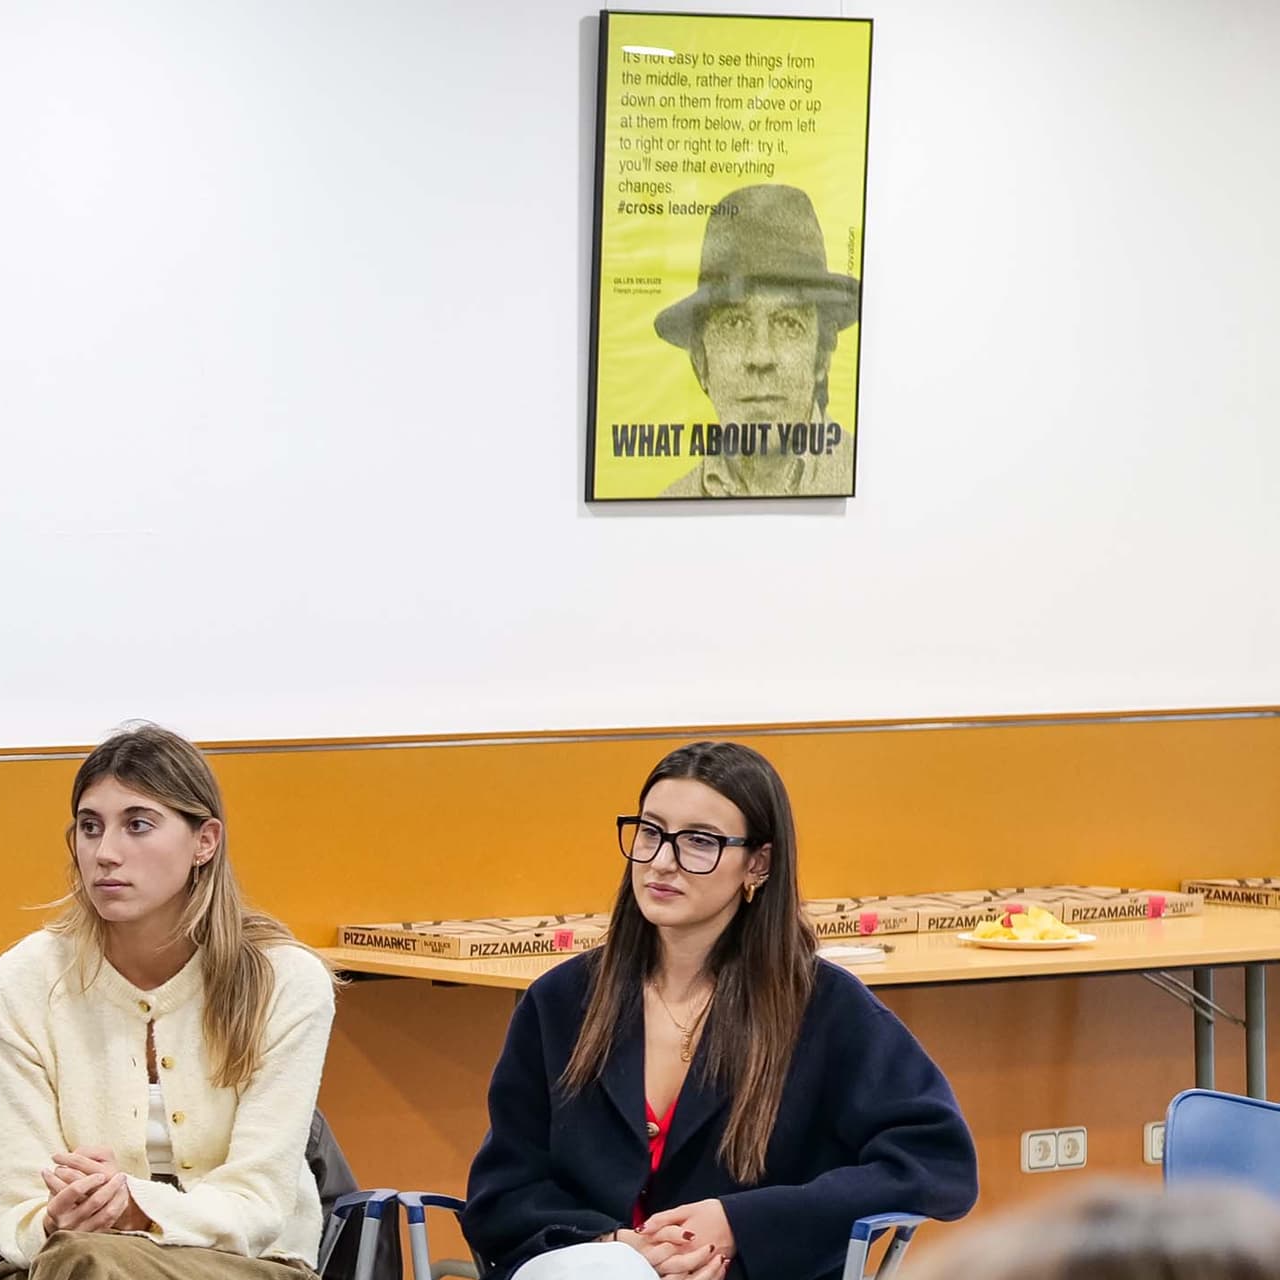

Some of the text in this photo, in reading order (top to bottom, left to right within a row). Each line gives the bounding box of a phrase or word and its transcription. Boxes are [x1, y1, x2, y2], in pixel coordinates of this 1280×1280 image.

[669, 52, 698, 69] easy
[703, 52, 714, 66] to
[718, 55, 741, 67] see
[745, 53, 782, 70] things
[787, 54, 815, 68] from
[622, 72, 813, 93] the middle, rather than looking
[621, 93, 822, 114] down on them from above or up
[620, 116, 816, 132] at them from below, or from left
[620, 137, 631, 149] to
[635, 136, 663, 153] right
[667, 140, 680, 150] or
[684, 137, 711, 154] right
[715, 138, 727, 151] to
[758, 140, 773, 155] try
[777, 140, 789, 155] it,
[619, 158, 775, 176] you'll see that everything
[618, 179, 674, 195] changes.
[618, 201, 739, 218] #cross leadership
[612, 423, 841, 456] WHAT ABOUT YOU?
[1072, 904, 1148, 920] PIZZAMARKE
[816, 920, 860, 936] MARKE
[344, 932, 417, 951] PIZZAMARKET
[469, 939, 564, 956] PIZZAMARKE
